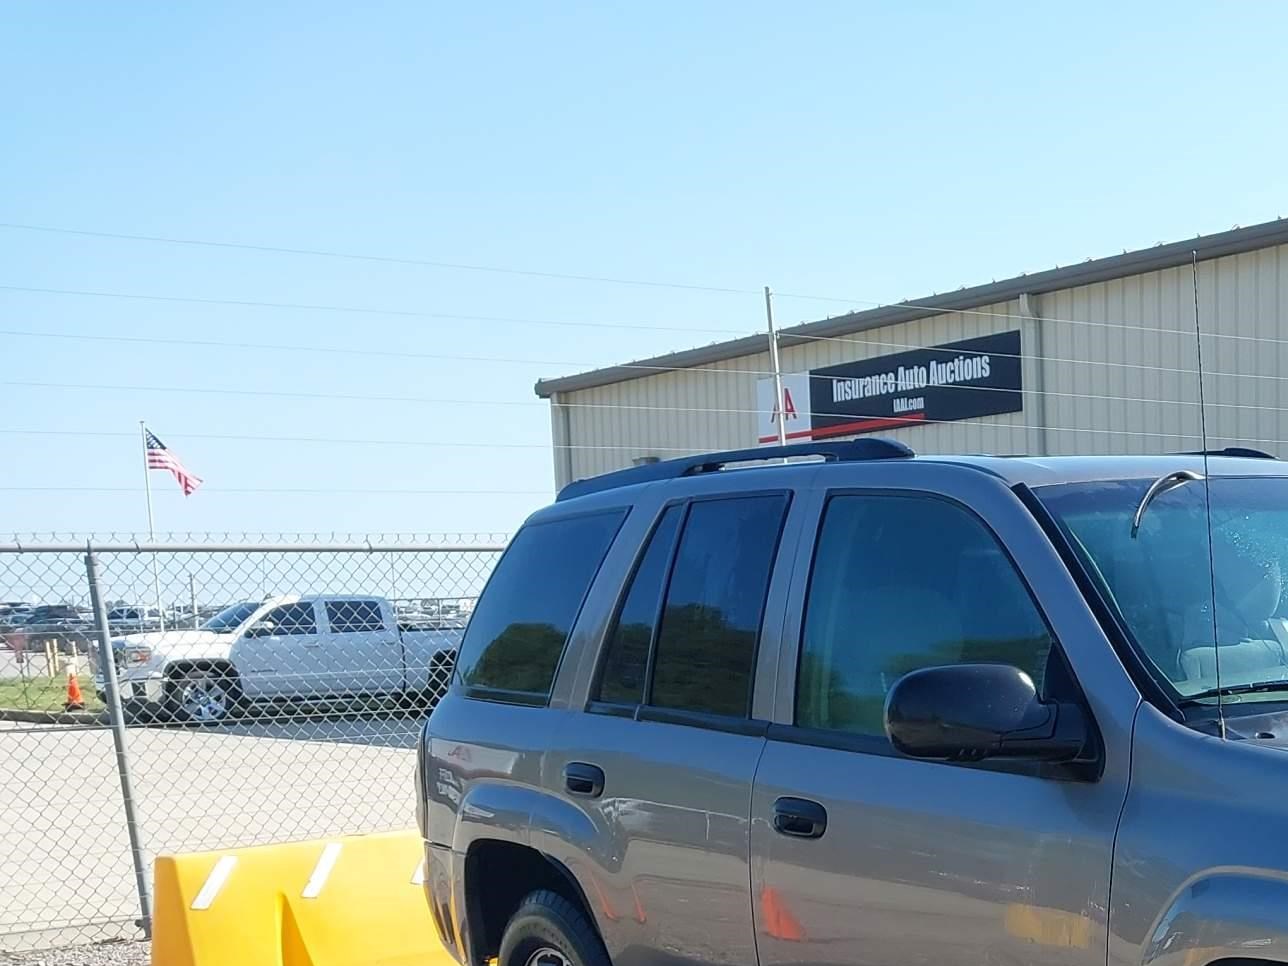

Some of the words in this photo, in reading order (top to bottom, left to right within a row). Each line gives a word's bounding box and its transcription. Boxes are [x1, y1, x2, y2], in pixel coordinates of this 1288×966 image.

[832, 373, 896, 402] Insurance
[897, 366, 927, 392] Auto
[929, 355, 991, 386] Auctions
